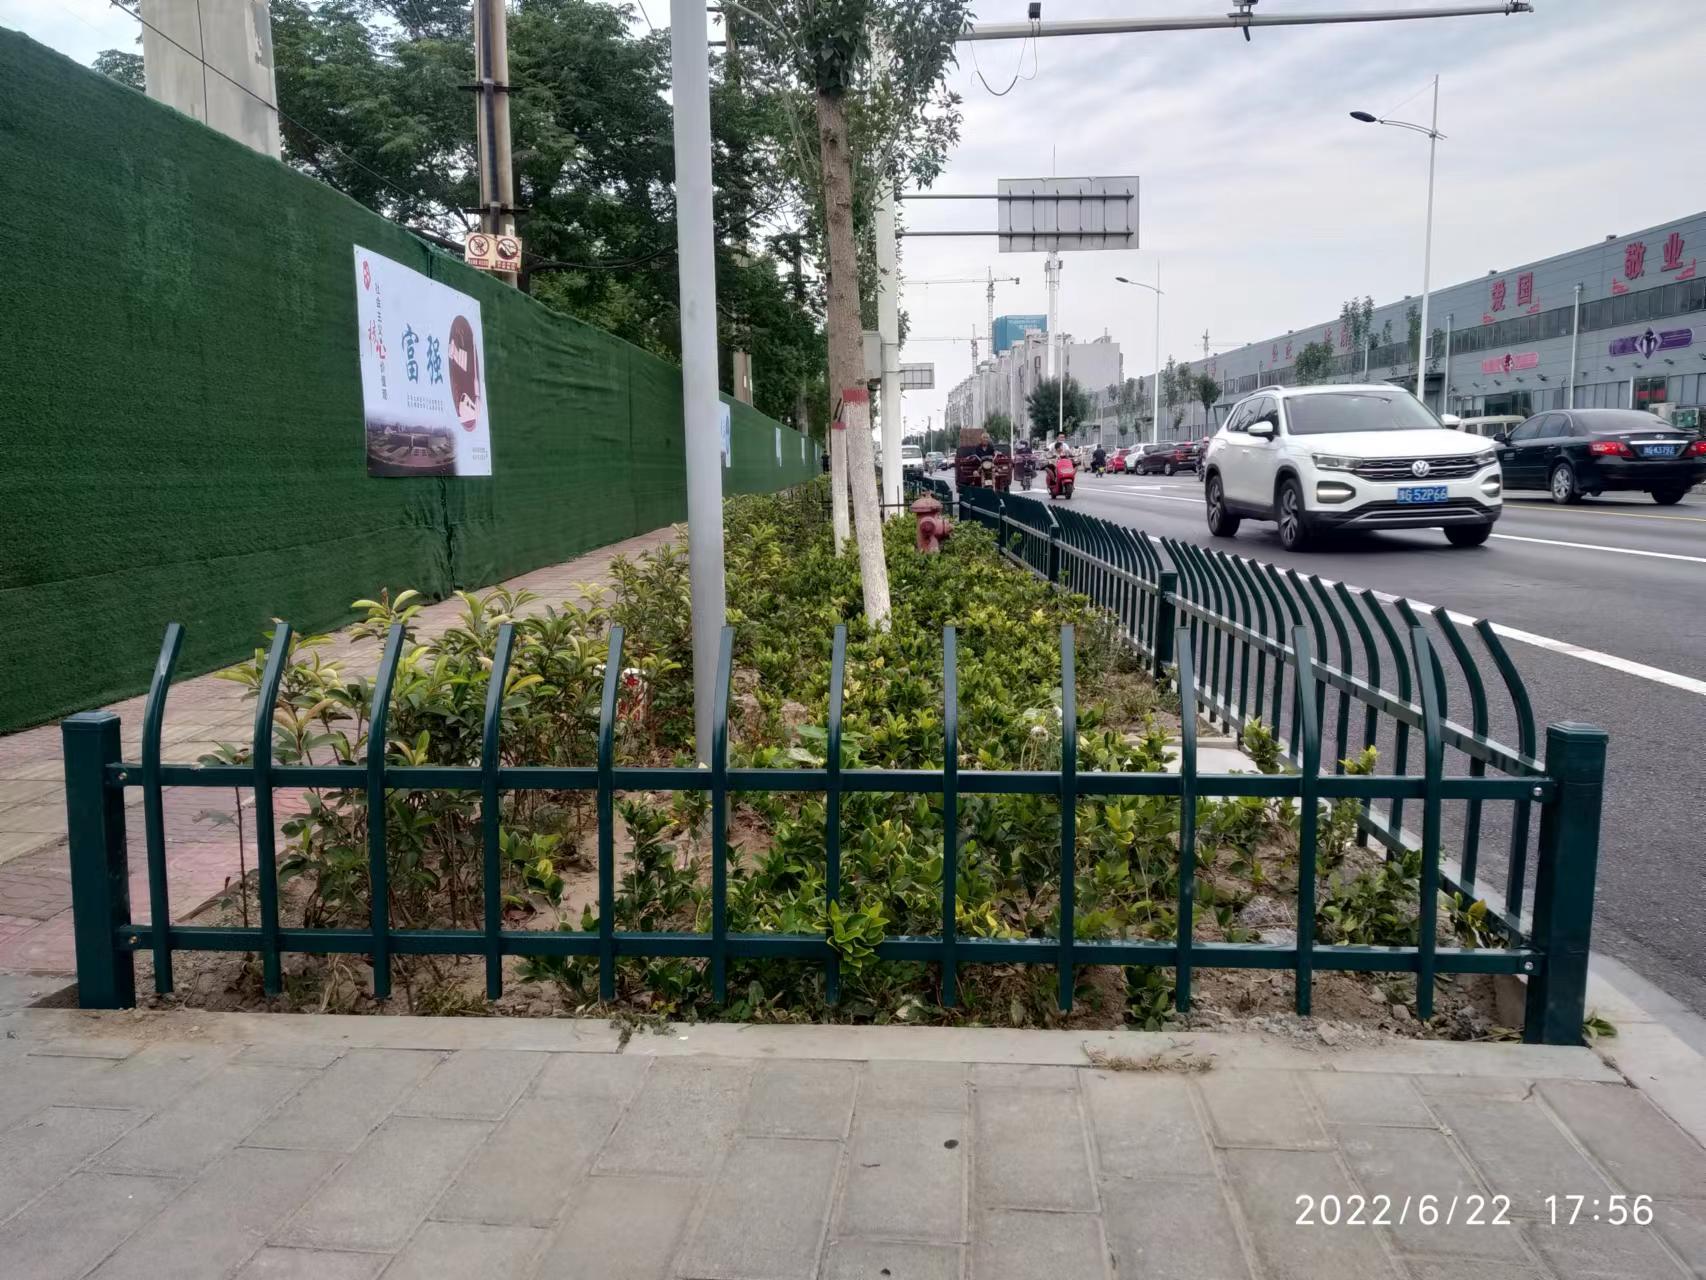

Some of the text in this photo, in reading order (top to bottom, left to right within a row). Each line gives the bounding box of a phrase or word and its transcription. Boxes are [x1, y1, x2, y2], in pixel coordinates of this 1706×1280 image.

[1624, 232, 1685, 280] 敬业
[1491, 272, 1534, 312] 爱国
[402, 323, 443, 385] 富强
